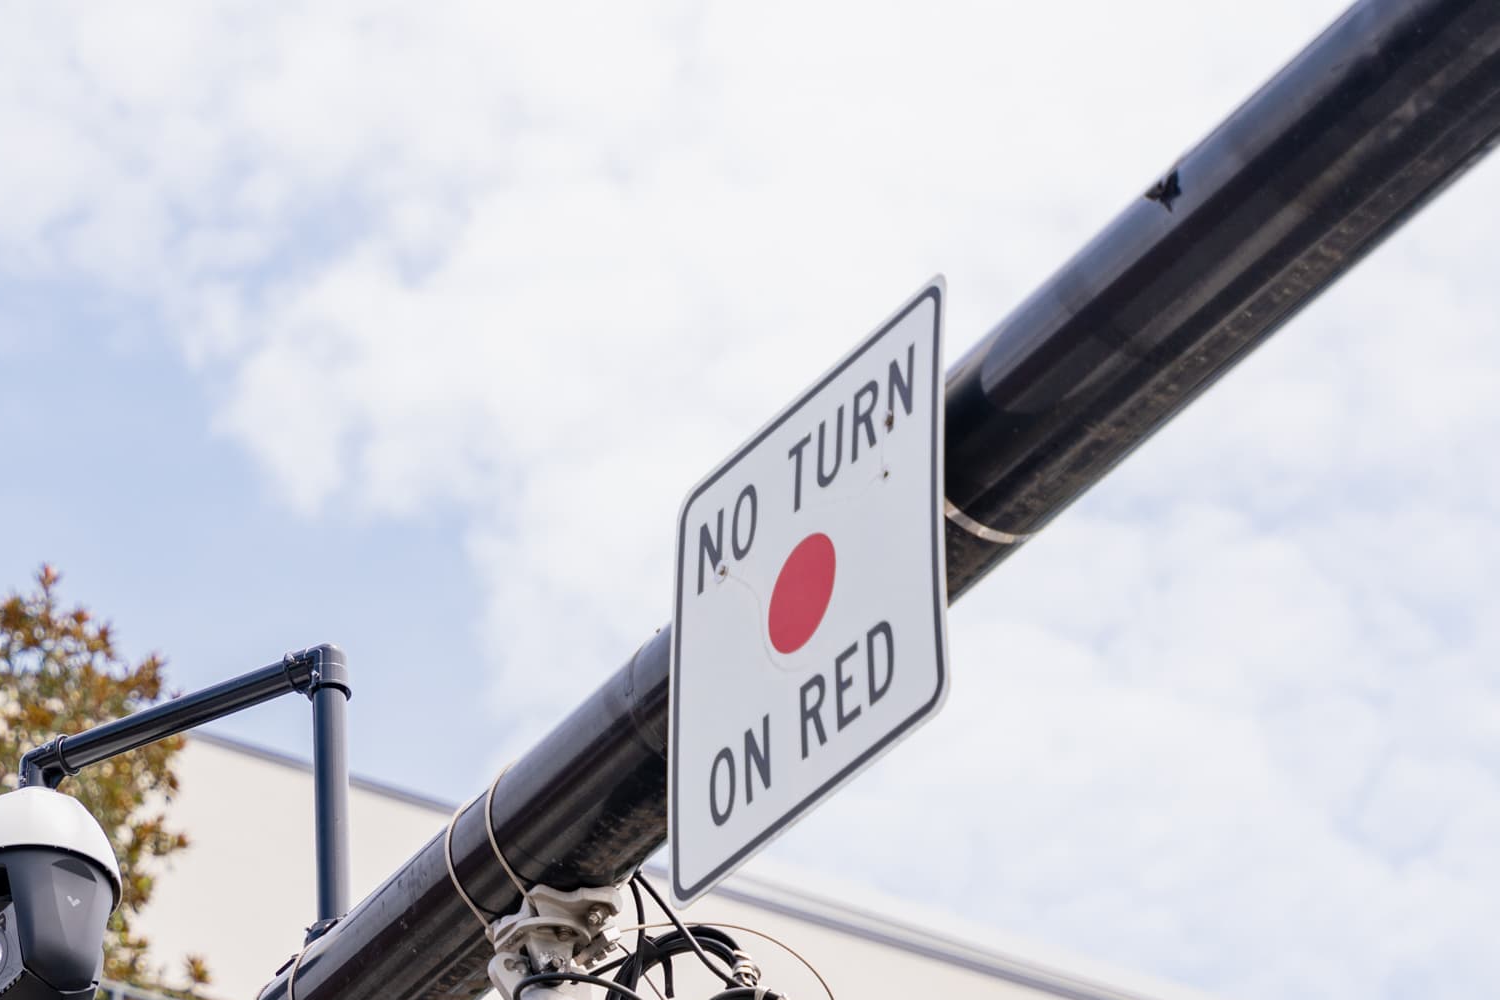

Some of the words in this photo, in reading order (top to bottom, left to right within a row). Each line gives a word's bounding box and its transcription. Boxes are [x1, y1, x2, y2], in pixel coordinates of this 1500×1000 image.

[696, 484, 758, 596] NO
[787, 343, 915, 513] TURN
[708, 713, 772, 827] ON
[800, 620, 895, 761] RED
